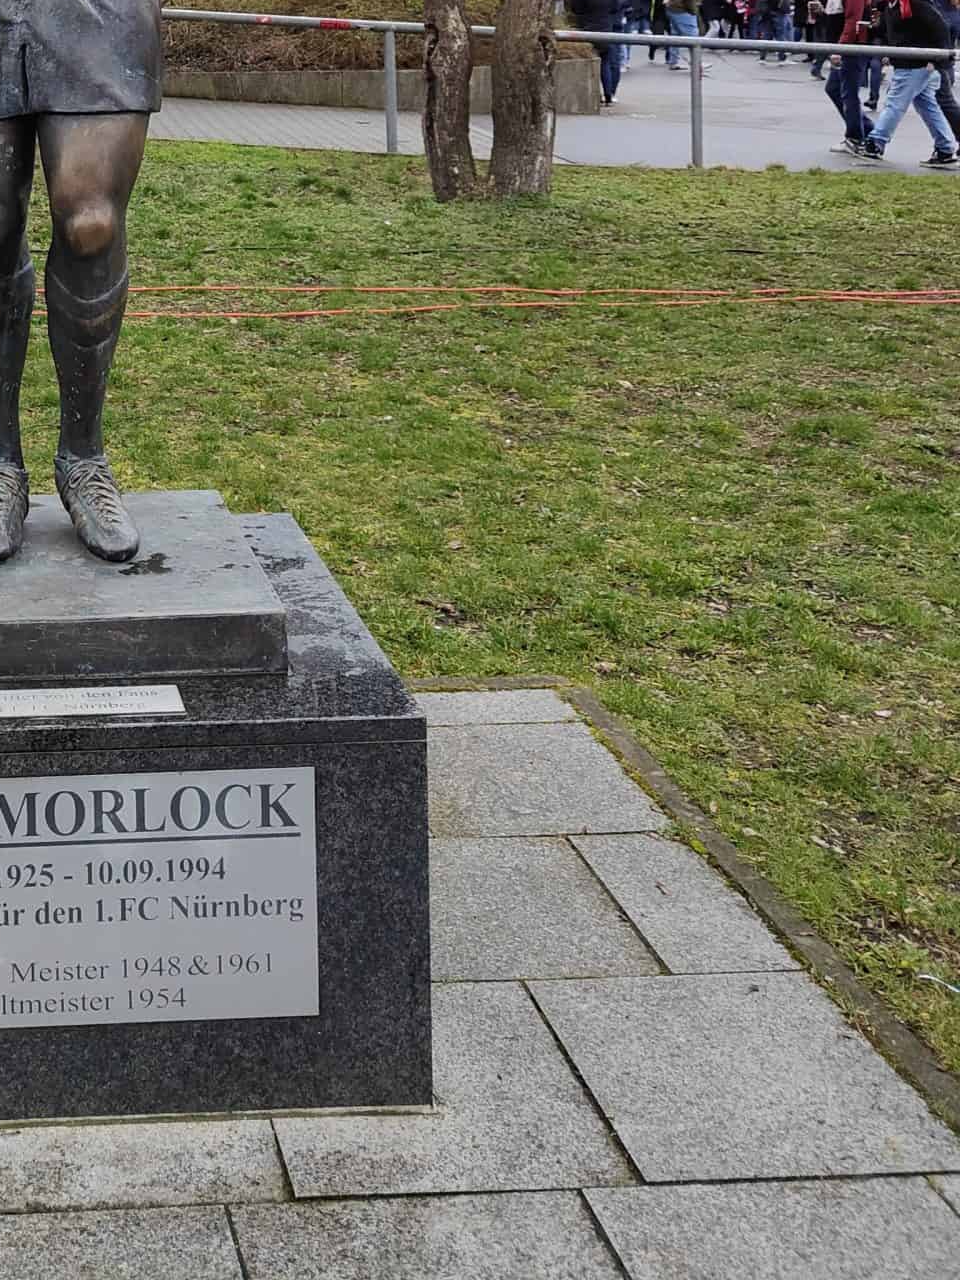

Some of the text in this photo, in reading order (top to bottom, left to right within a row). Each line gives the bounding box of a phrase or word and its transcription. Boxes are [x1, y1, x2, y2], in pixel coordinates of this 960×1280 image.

[81, 689, 112, 698] den
[85, 856, 226, 885] 10.09.1994
[35, 901, 82, 925] den
[169, 893, 304, 921] Nürnberg
[11, 960, 109, 983] Meister
[128, 987, 187, 1010] 1954
